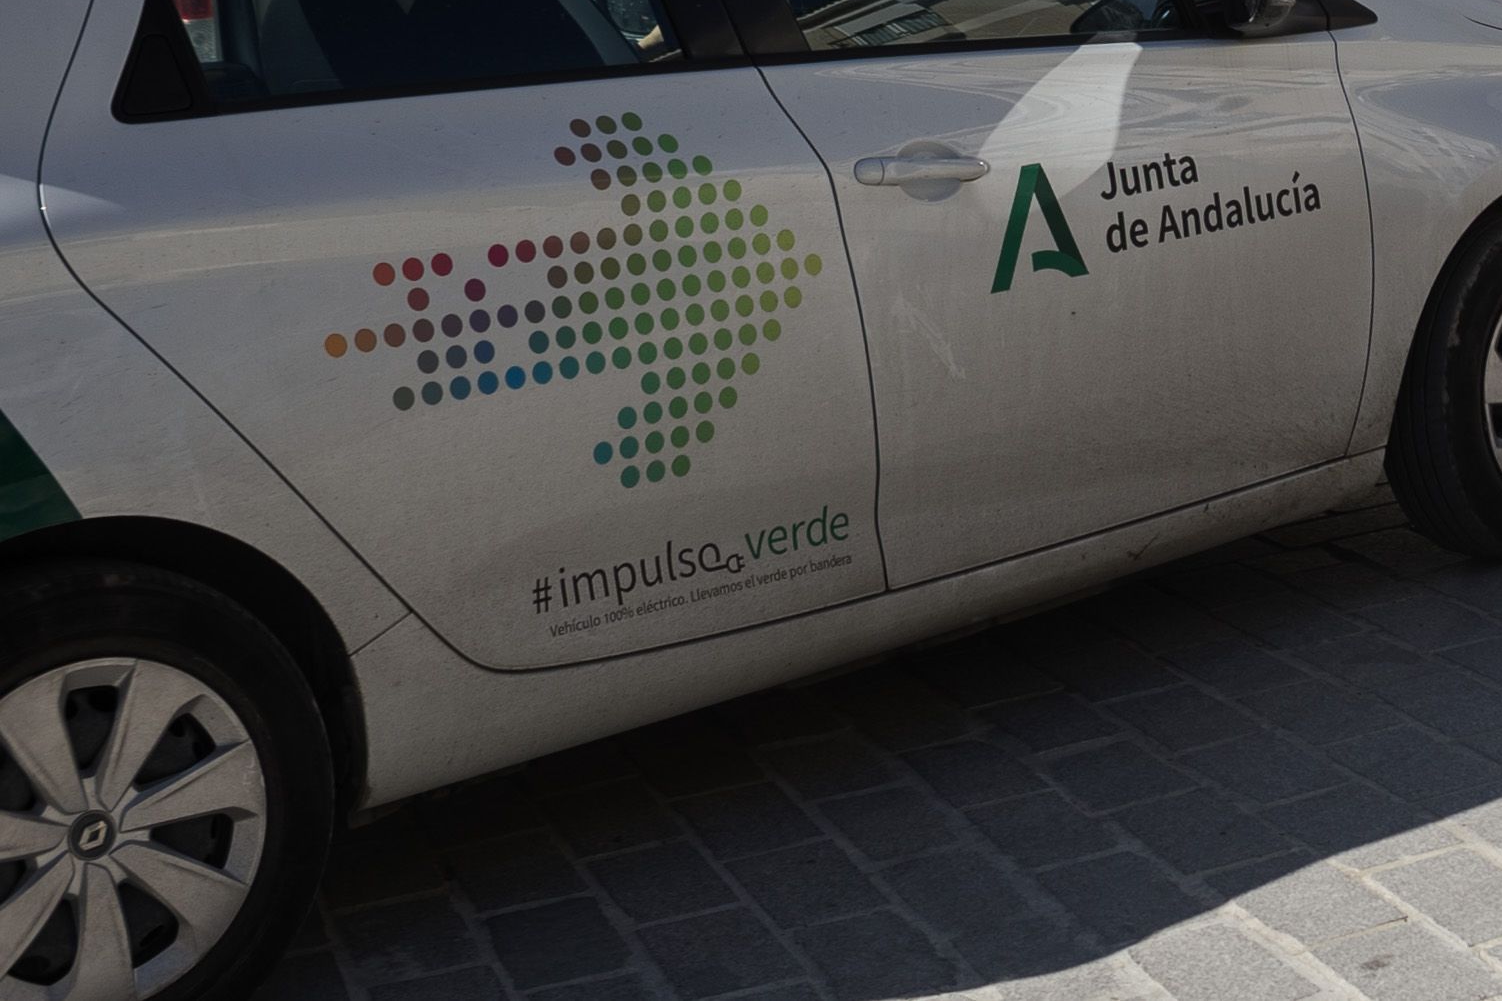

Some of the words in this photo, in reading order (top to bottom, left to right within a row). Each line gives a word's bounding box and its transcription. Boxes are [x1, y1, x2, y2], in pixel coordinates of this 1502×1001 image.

[1100, 152, 1199, 200] Junta
[1106, 211, 1149, 253] de
[1159, 170, 1322, 243] Andalucía
[744, 505, 850, 560] verde
[550, 615, 601, 637] Vehículo
[604, 606, 635, 624] 100%
[636, 595, 689, 616] eléctrico.
[690, 581, 743, 603] Llevamos
[745, 575, 756, 589] el
[757, 569, 787, 586] verde
[789, 565, 808, 580] por
[809, 554, 853, 573] bandera
